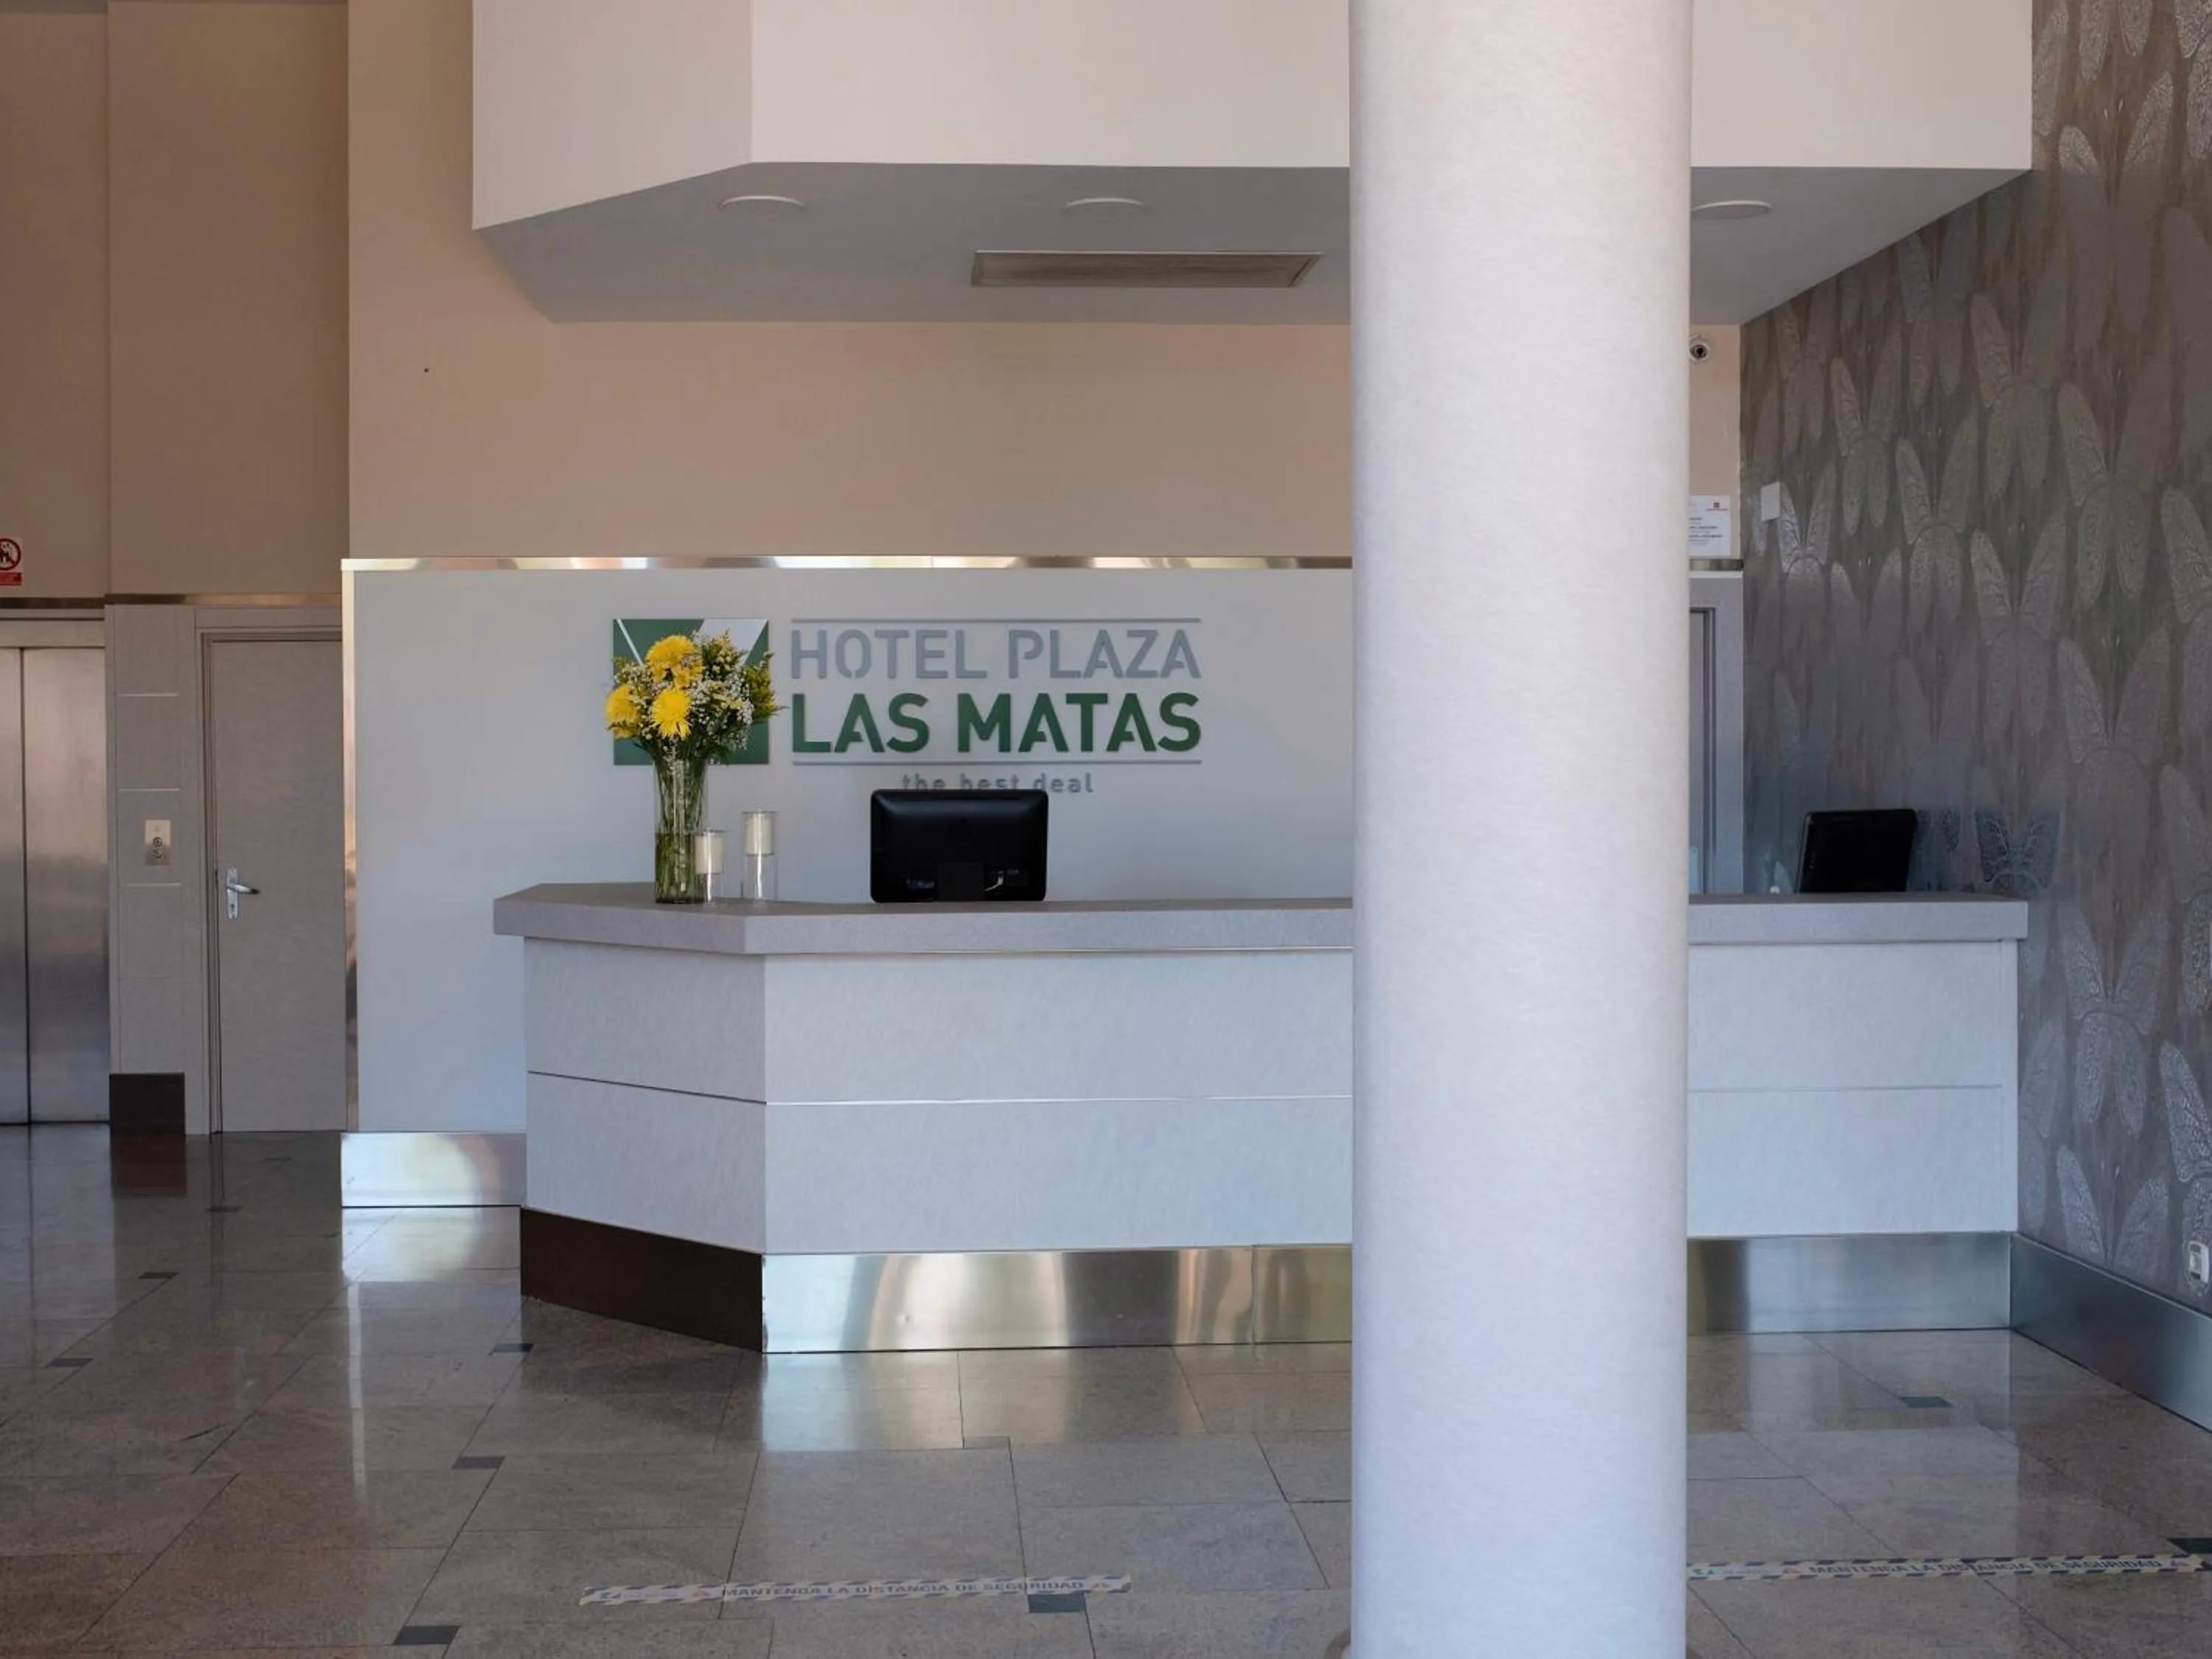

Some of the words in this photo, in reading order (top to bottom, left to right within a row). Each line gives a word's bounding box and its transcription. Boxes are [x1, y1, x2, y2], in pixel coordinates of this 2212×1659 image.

[791, 629, 988, 679] HOTEL
[1008, 629, 1202, 679] PLAZA
[792, 692, 931, 753] LAS
[957, 692, 1202, 752] MATAS
[902, 773, 946, 790] the
[960, 773, 1020, 790] best
[1033, 772, 1093, 793] deal
[1809, 1564, 1908, 1574] MANTENGA
[726, 1586, 821, 1596] MANTENGA
[827, 1585, 850, 1595] LA
[855, 1585, 950, 1594] DISTANCIA
[955, 1583, 978, 1593] DE
[983, 1582, 1085, 1591] SEGURIDAD
